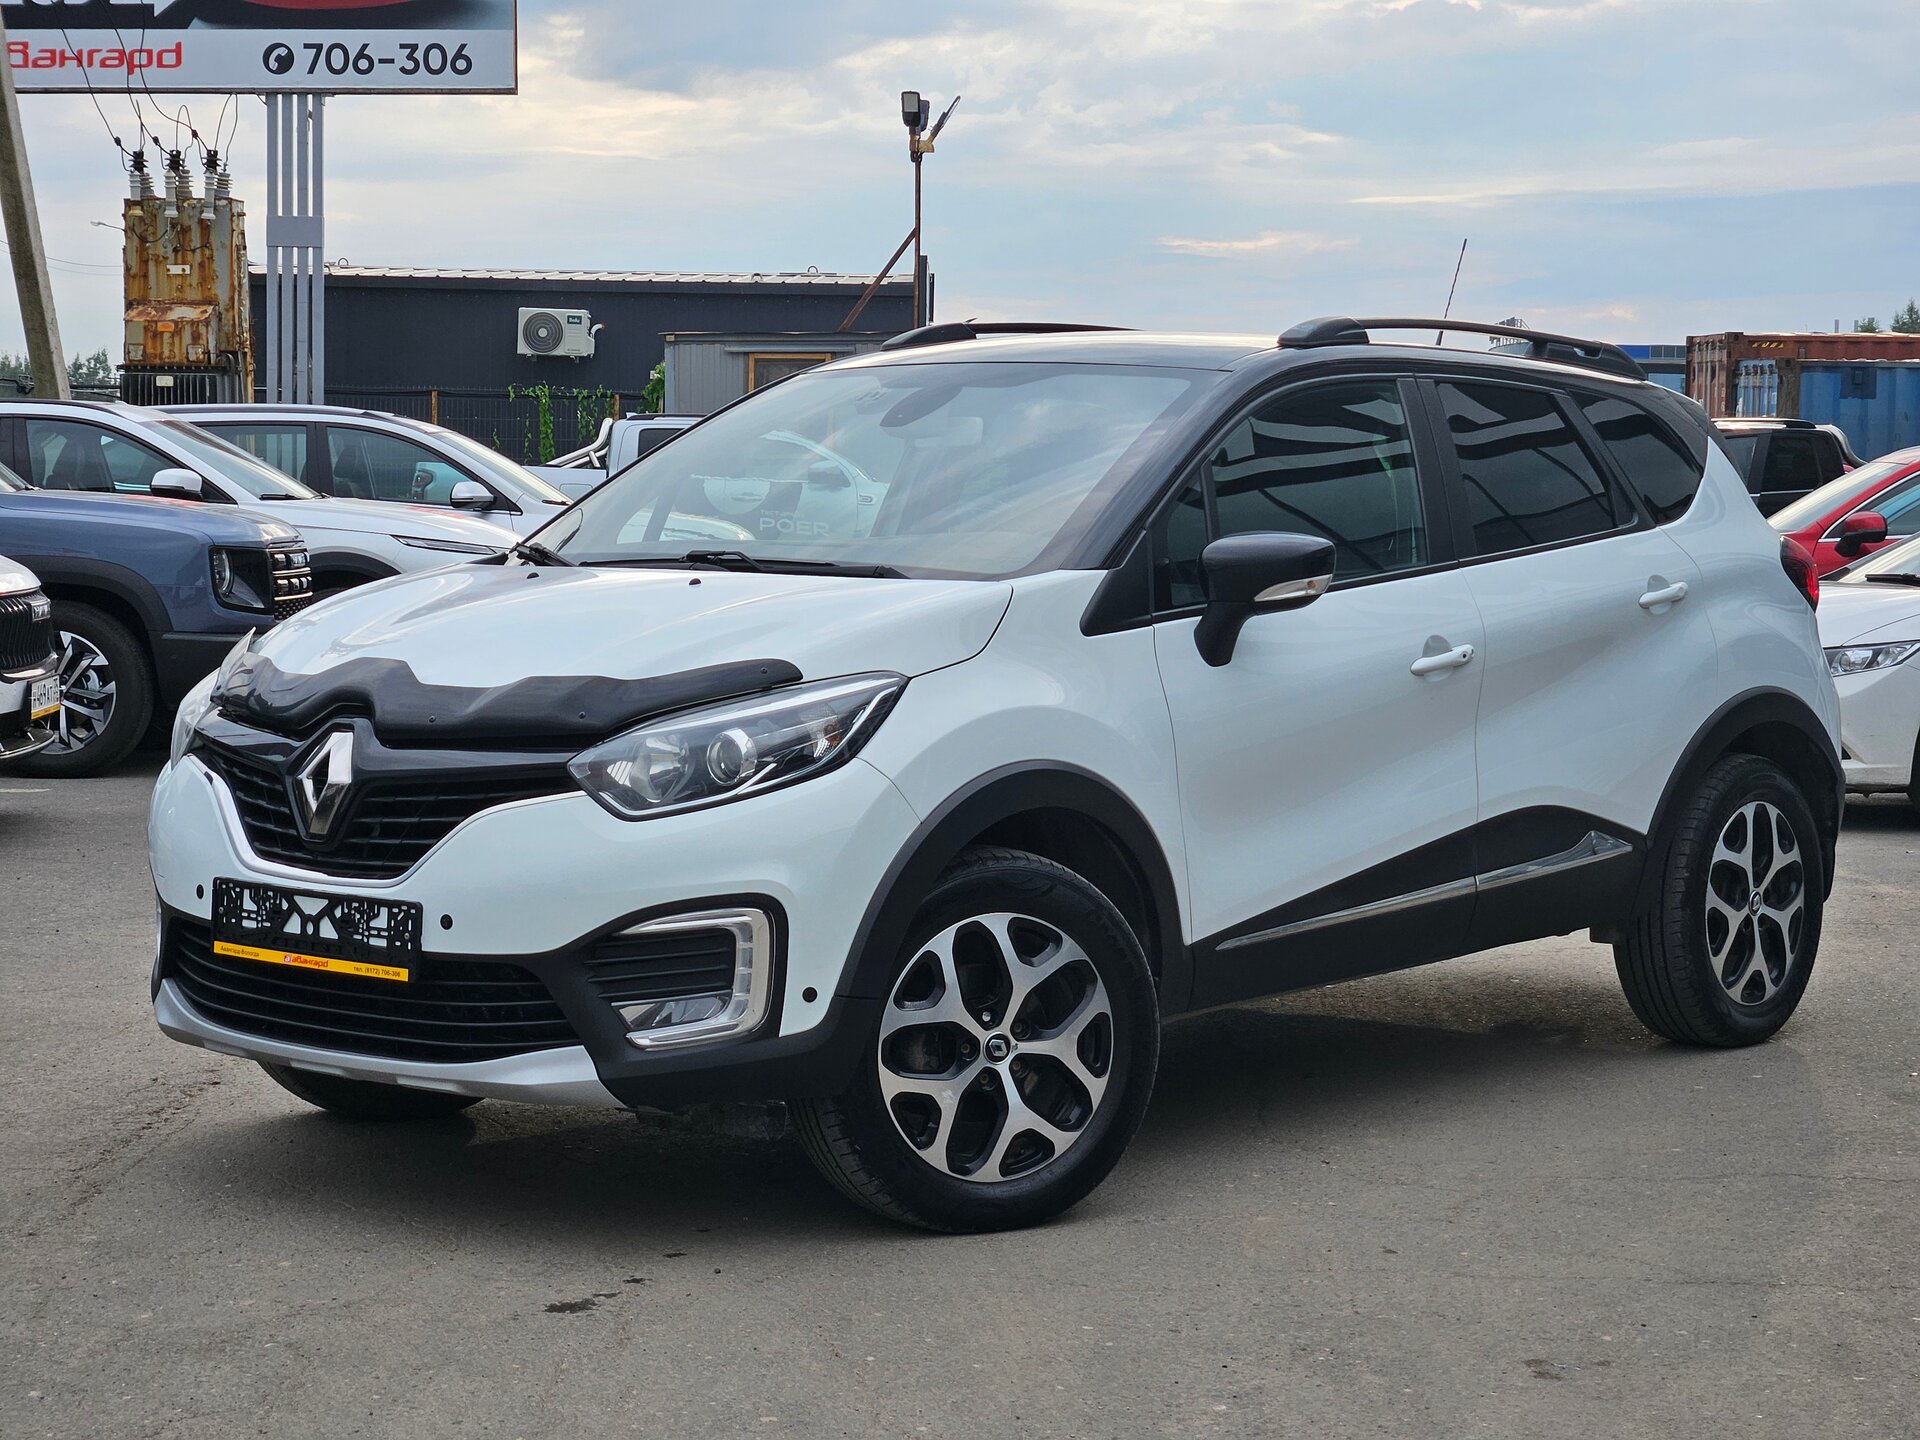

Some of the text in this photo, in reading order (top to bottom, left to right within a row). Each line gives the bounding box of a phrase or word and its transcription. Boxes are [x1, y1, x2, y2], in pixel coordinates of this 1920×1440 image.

[302, 42, 473, 76] 706-306
[759, 517, 831, 537] POER
[381, 968, 401, 978] 706-306
